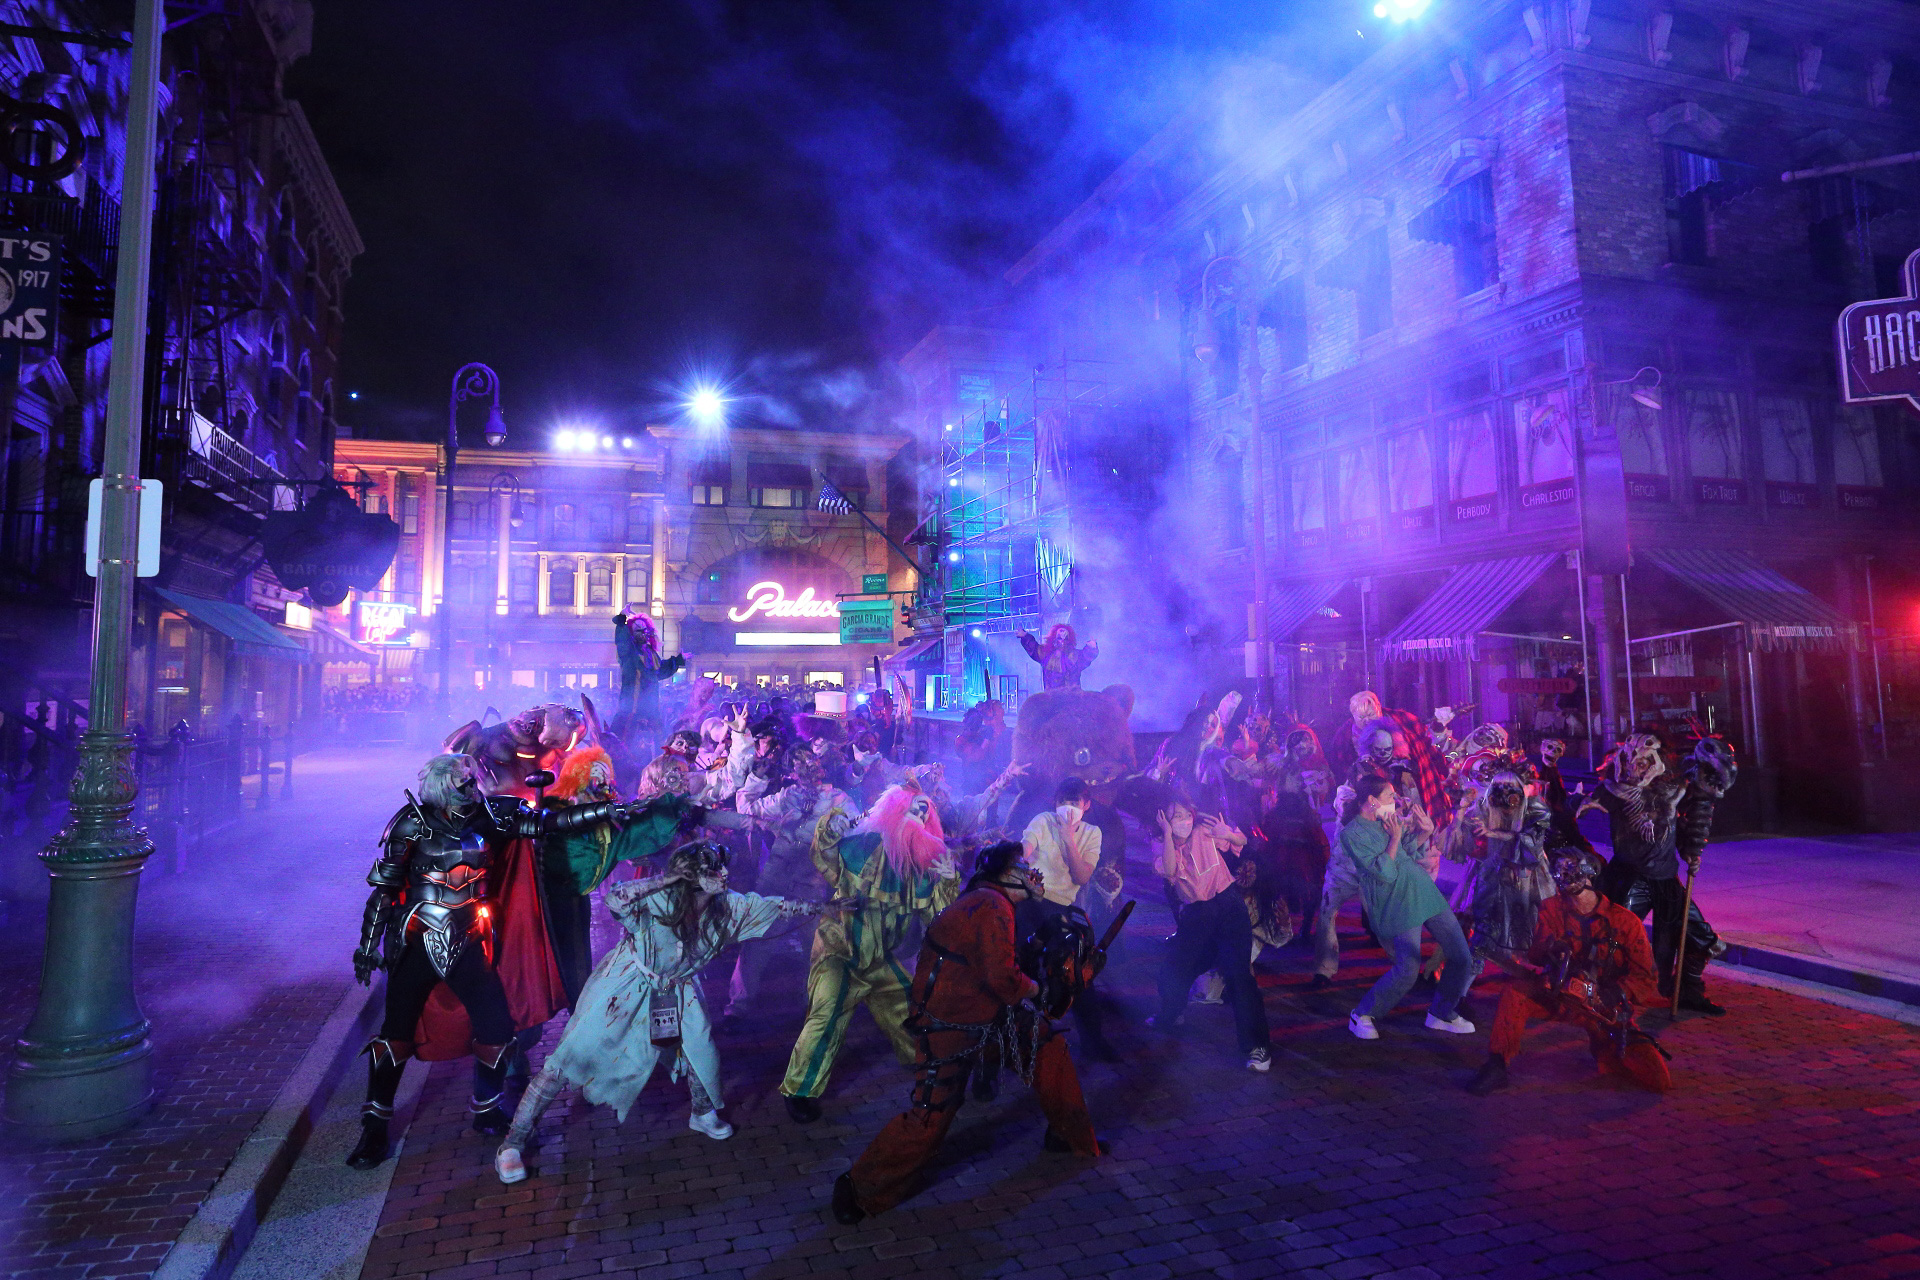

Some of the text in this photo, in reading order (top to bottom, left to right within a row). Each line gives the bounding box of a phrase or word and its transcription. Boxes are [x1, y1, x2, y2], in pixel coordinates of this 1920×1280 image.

[18, 269, 50, 289] 1917
[1522, 488, 1574, 507] CHARLESTON
[1457, 503, 1491, 520] PEABODY
[865, 613, 890, 629] GRANDE
[1805, 625, 1824, 637] MUSIC
